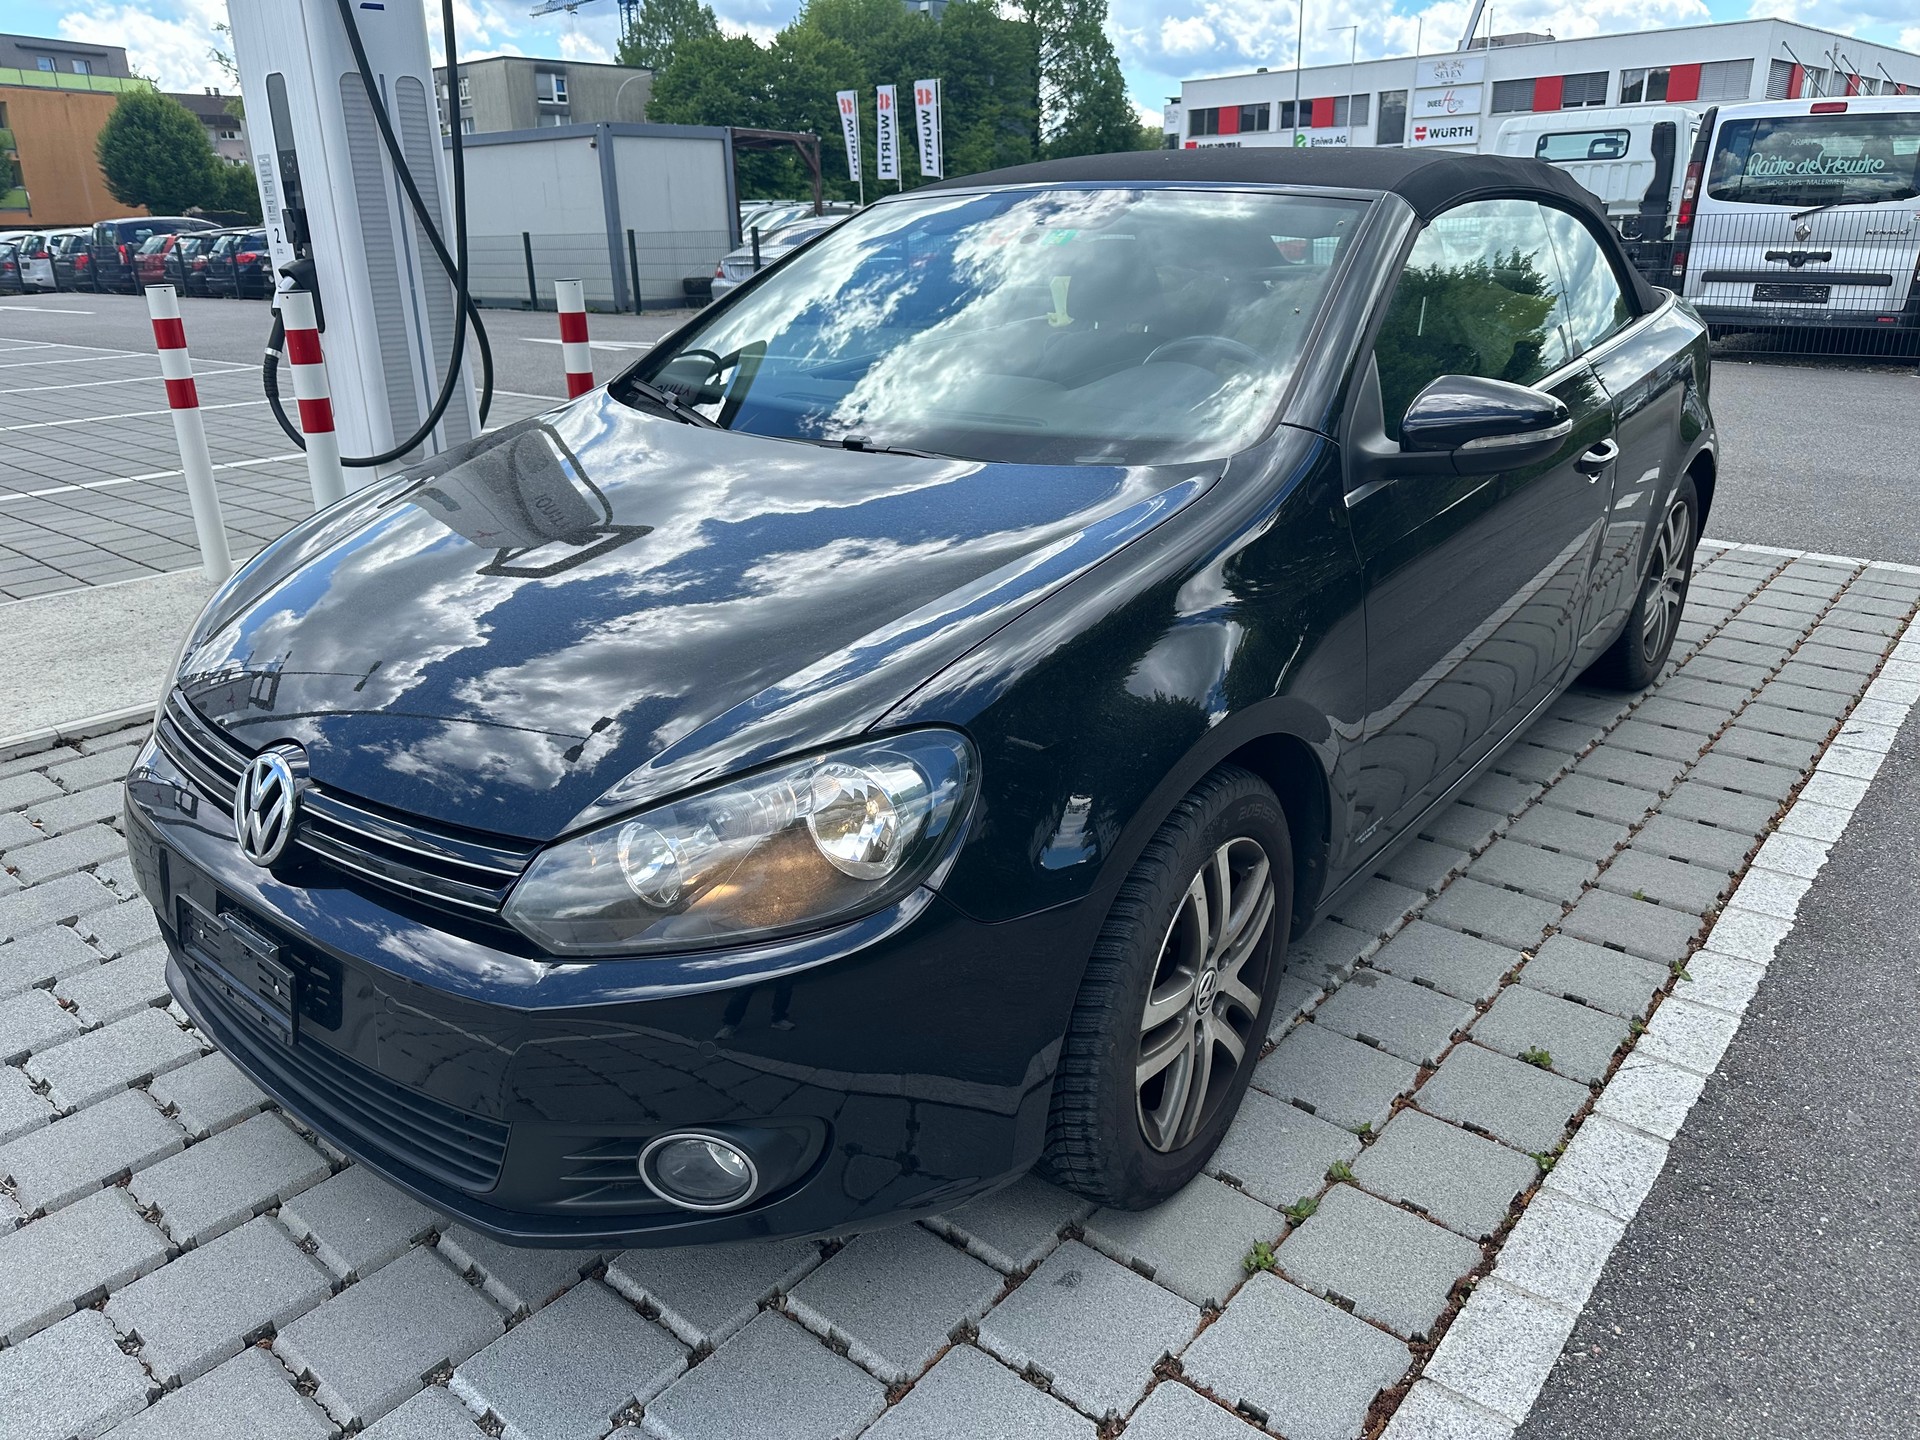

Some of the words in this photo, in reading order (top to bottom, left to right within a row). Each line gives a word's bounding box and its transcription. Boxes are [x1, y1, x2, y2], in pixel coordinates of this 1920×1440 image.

[1434, 69, 1462, 79] SEVEN
[1429, 126, 1473, 138] WÜRTH
[1310, 136, 1333, 146] Eniwa
[1334, 134, 1347, 144] AG
[1796, 157, 1816, 174] de
[273, 227, 282, 244] 2
